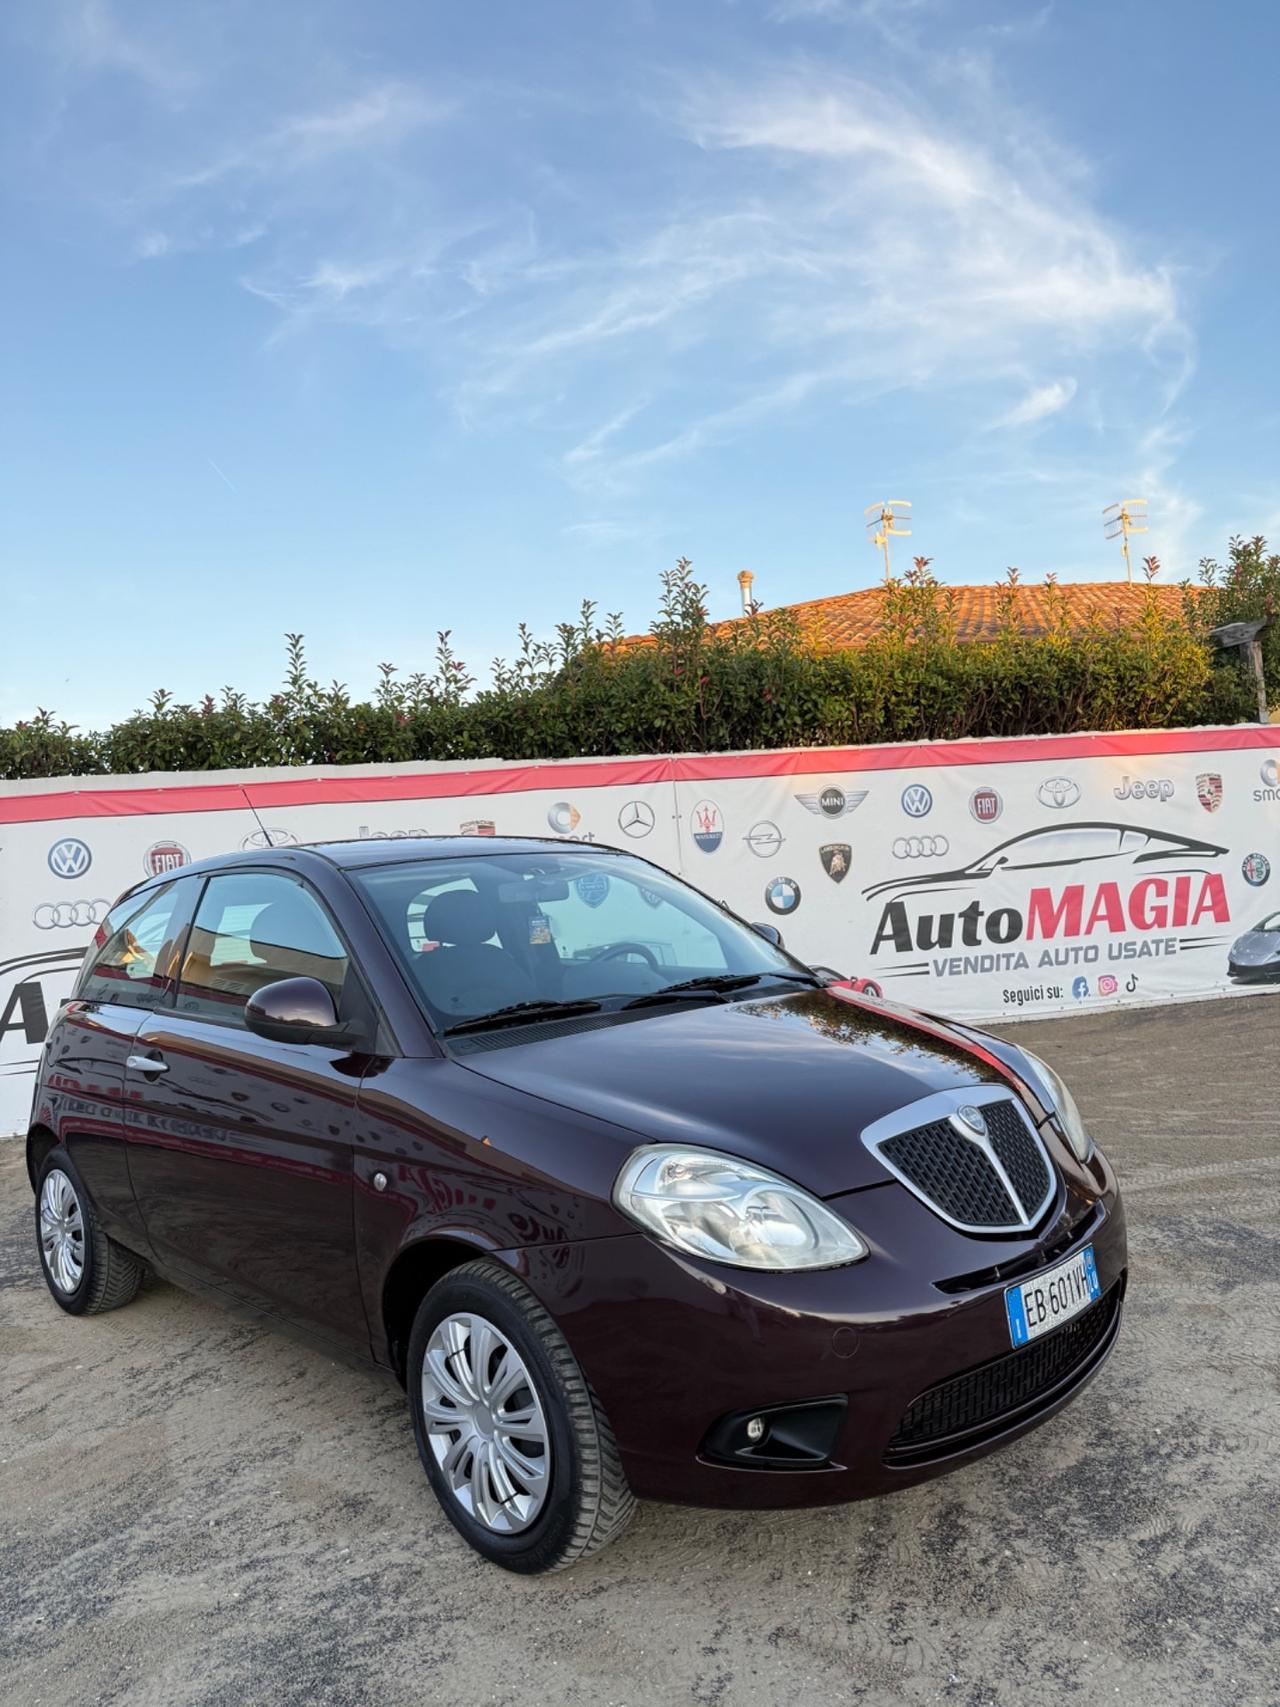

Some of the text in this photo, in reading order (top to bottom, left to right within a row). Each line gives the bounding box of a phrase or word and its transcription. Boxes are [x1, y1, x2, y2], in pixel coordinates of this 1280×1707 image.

[1113, 775, 1175, 802] Jeep
[821, 796, 844, 807] MINI
[976, 797, 996, 815] FIAT
[869, 873, 1231, 955] AutoMAGIA
[933, 937, 1177, 977] VENDITA AUTO USATE
[1002, 984, 1064, 1007] Seguici su:
